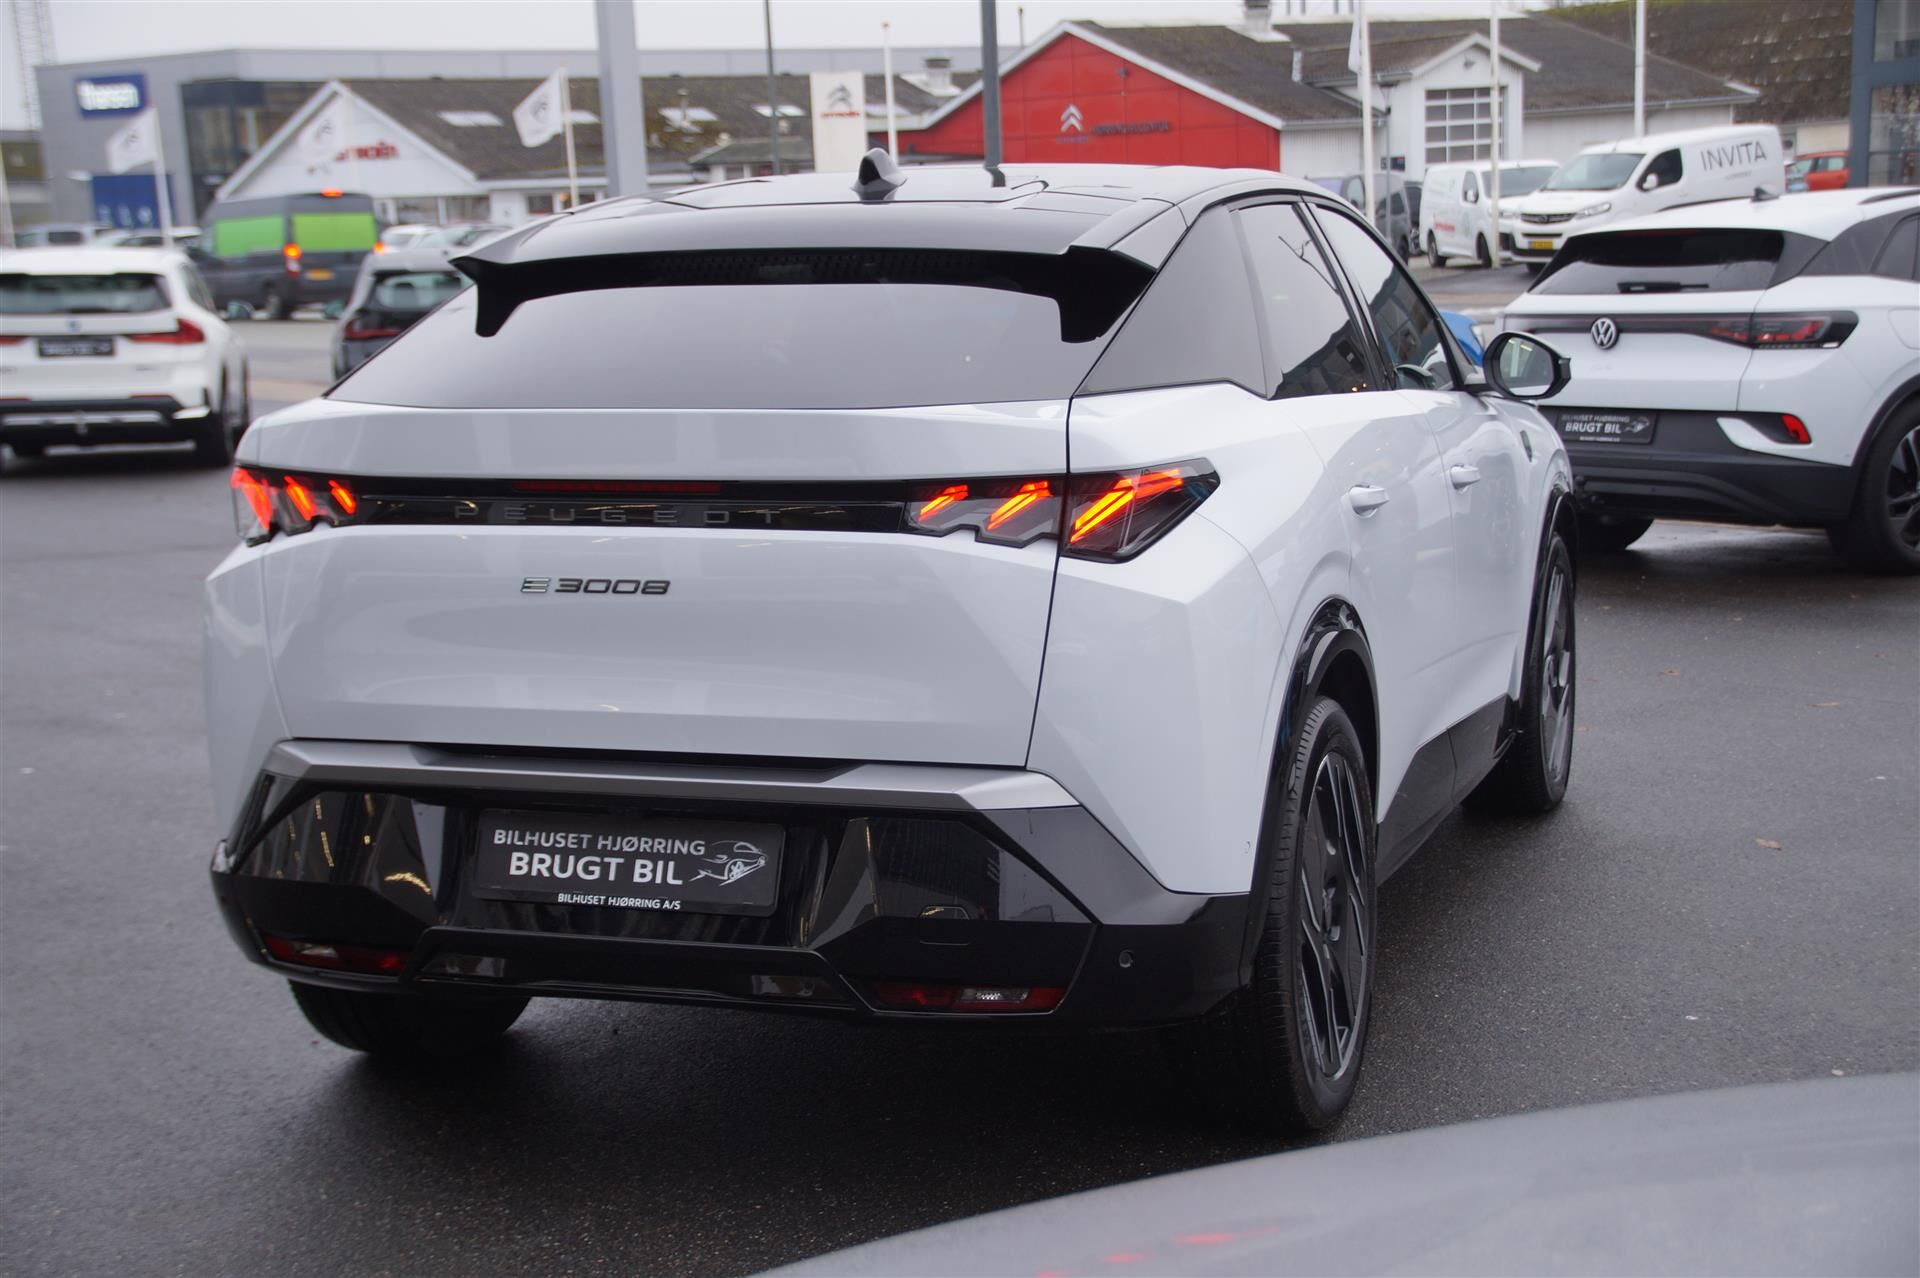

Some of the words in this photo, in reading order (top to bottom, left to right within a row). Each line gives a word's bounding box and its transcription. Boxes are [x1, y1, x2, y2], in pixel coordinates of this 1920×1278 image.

[1701, 141, 1767, 171] INVITA
[1565, 422, 1602, 433] BRUGT
[1604, 423, 1622, 434] BIL
[454, 505, 780, 524] PEUGEOT
[555, 578, 671, 595] 3008
[493, 829, 592, 849] BILHUSET
[597, 835, 706, 856] HJØRRING
[509, 852, 625, 881] BRUGT
[632, 859, 683, 885] BIL
[557, 892, 606, 905] BILHUSET
[607, 896, 661, 909] HJØRRING
[662, 899, 681, 910] A/S
